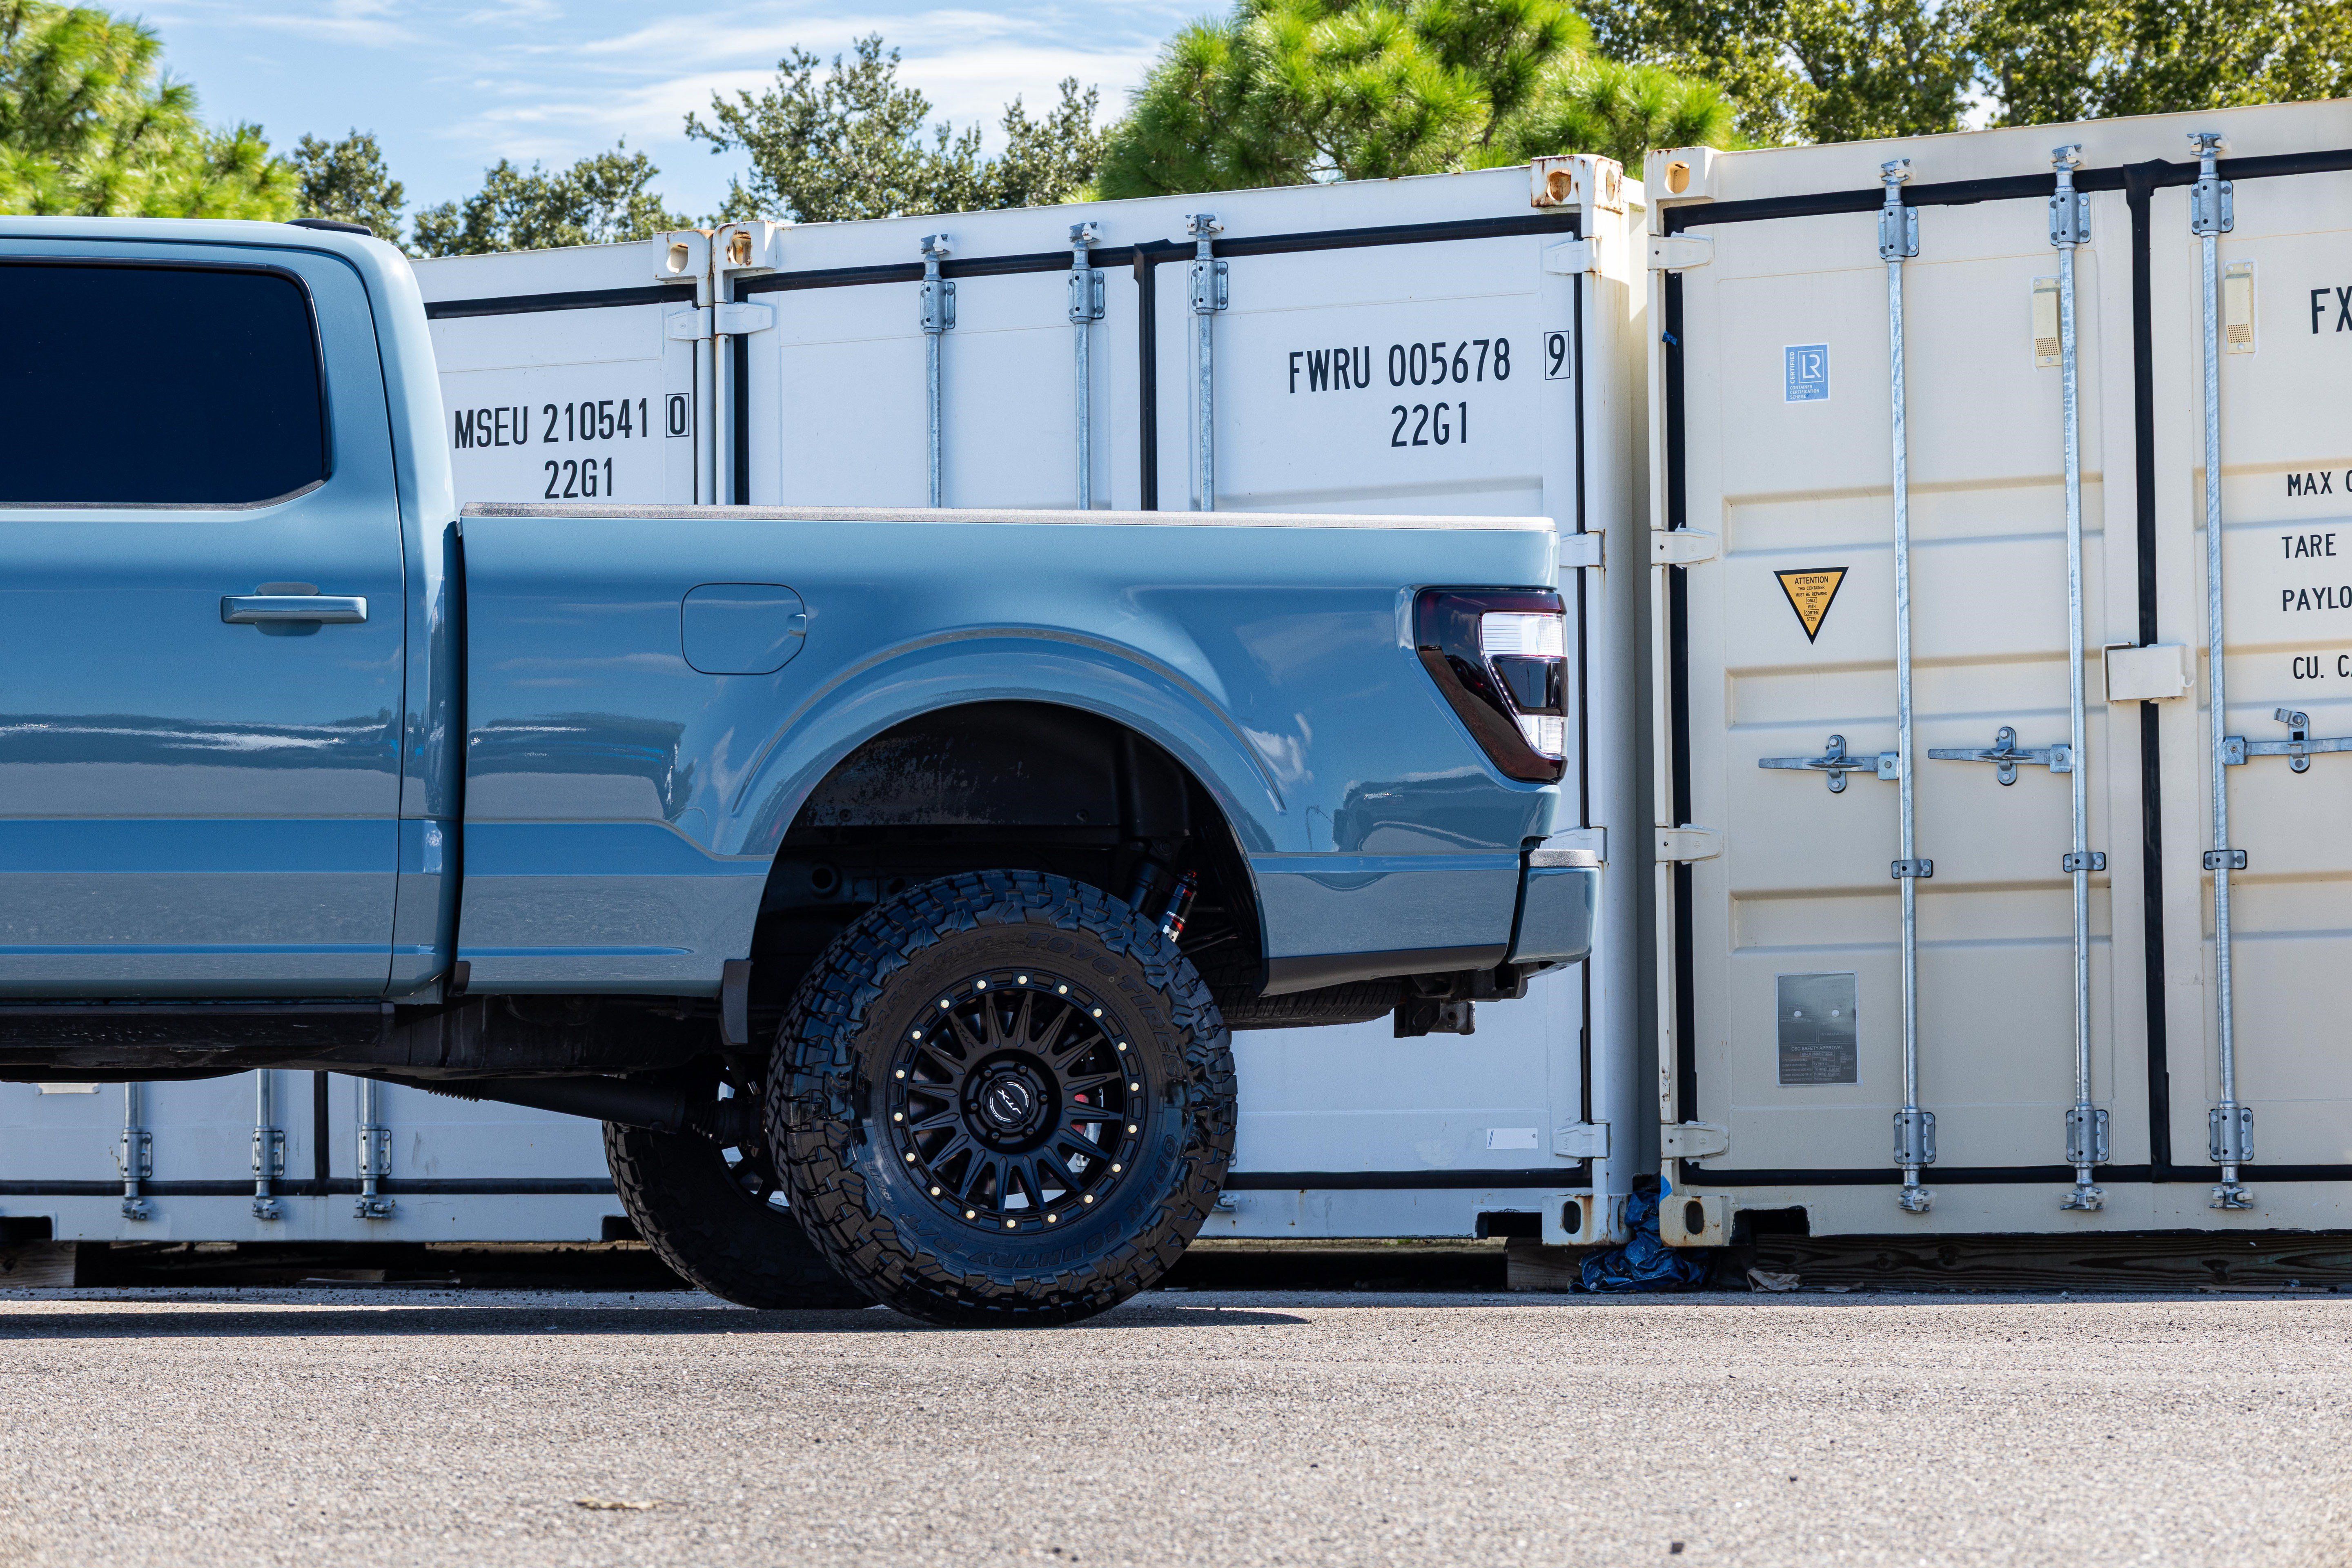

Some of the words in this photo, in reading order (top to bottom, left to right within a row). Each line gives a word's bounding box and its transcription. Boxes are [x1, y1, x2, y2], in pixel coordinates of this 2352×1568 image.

[1289, 346, 1370, 394] FWRU
[1389, 338, 1510, 387] 005678
[1549, 334, 1565, 376] 9
[1802, 354, 1822, 379] LR
[455, 406, 528, 448] MSEU
[543, 398, 647, 443] 210541
[670, 395, 686, 435] 0
[1391, 401, 1467, 447] 22G1
[545, 457, 612, 499] 22G1
[2287, 471, 2333, 497] MAX
[2282, 533, 2336, 559] TARE
[1795, 576, 1829, 585] ATTENTION
[2283, 586, 2352, 612] PAYLO
[2293, 656, 2324, 679] CU.
[2338, 655, 2352, 678] C
[1026, 932, 1119, 976] TOYO
[1118, 975, 1183, 1078] TIRES
[989, 1105, 1003, 1120] DRIVE
[1125, 1135, 1178, 1223] OPEN
[899, 1214, 962, 1254] R/T
[968, 1220, 1123, 1268] COUNTRY
